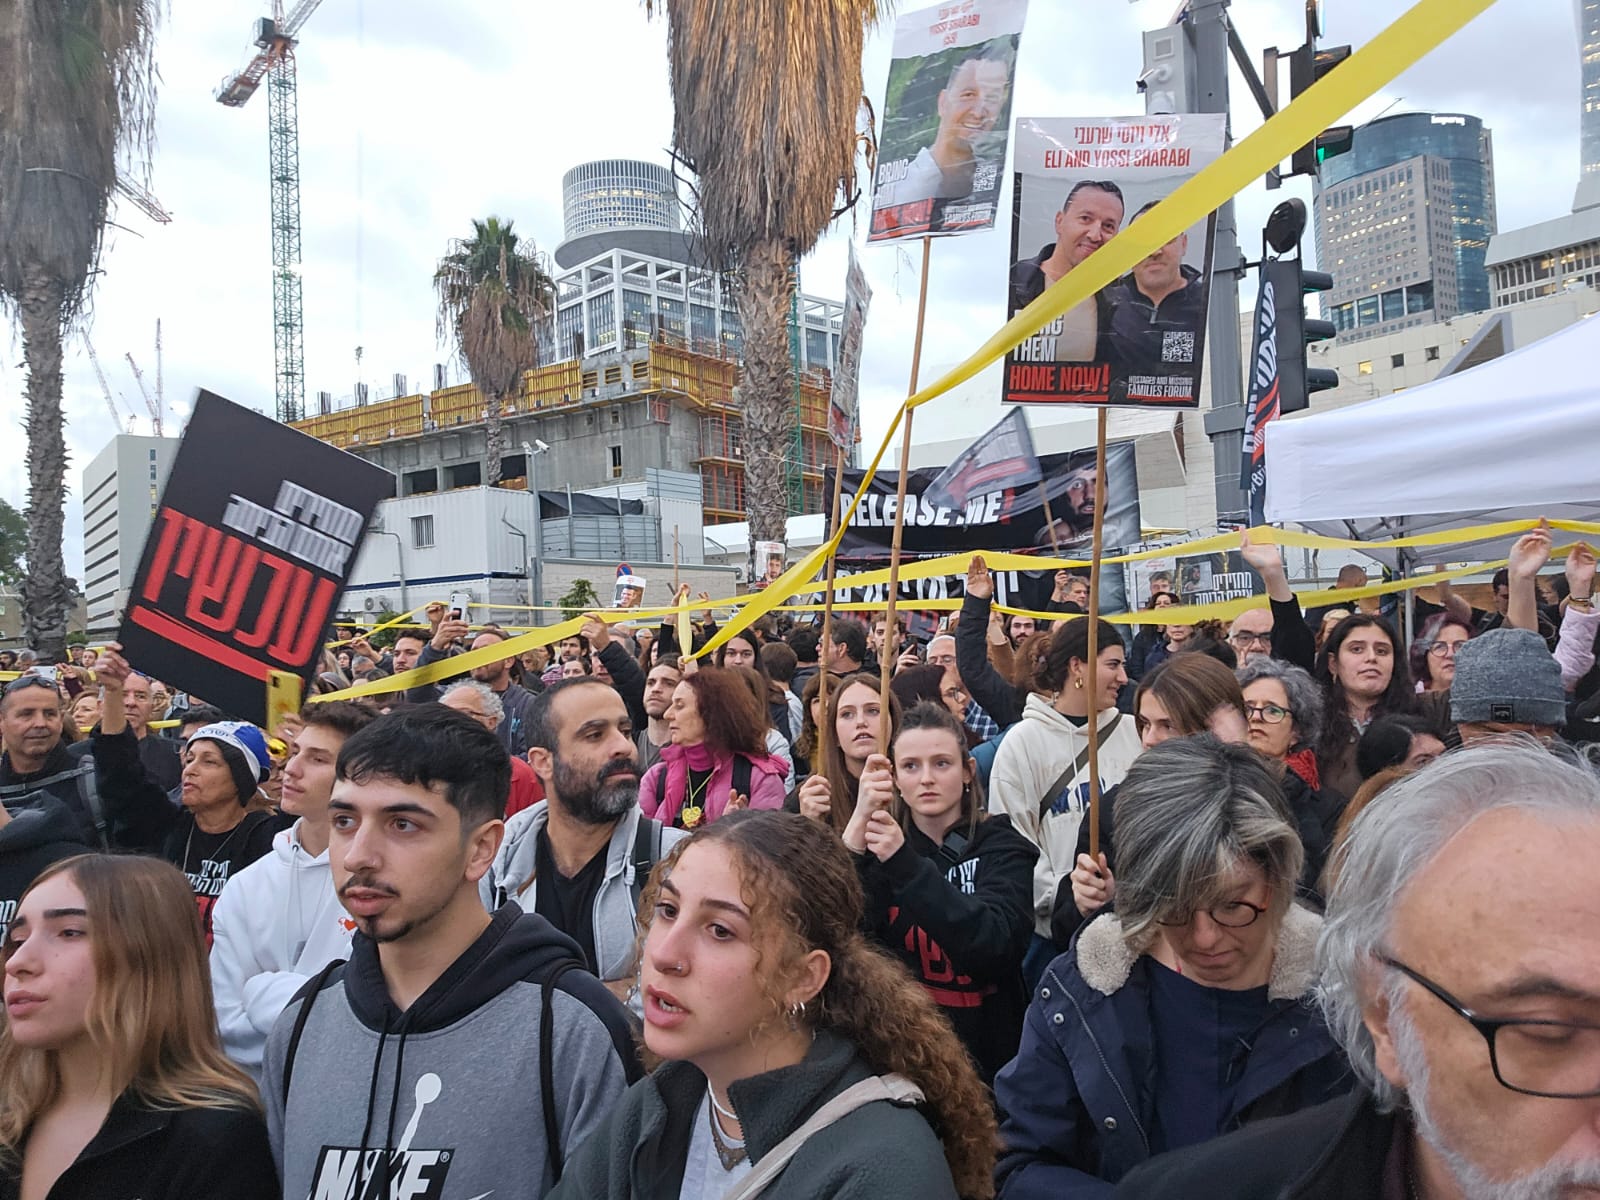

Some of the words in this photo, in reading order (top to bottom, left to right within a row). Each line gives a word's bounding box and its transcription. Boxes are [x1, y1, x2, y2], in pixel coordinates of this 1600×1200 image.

[1074, 127, 1112, 144] שרעבי
[1149, 125, 1170, 142] אלי
[1045, 151, 1062, 168] ELI
[1065, 150, 1090, 168] AND
[1095, 150, 1129, 168] YOSSI
[1134, 148, 1190, 167] SHARABI
[879, 159, 909, 184] BRING
[1009, 366, 1056, 391] HOME
[1059, 363, 1110, 392] NOW!
[1128, 384, 1162, 397] FAMILIES
[1163, 386, 1192, 398] FORUM
[840, 493, 951, 526] RELEASE
[143, 507, 337, 667] עכשיו
[1213, 571, 1253, 591] מחזירים
